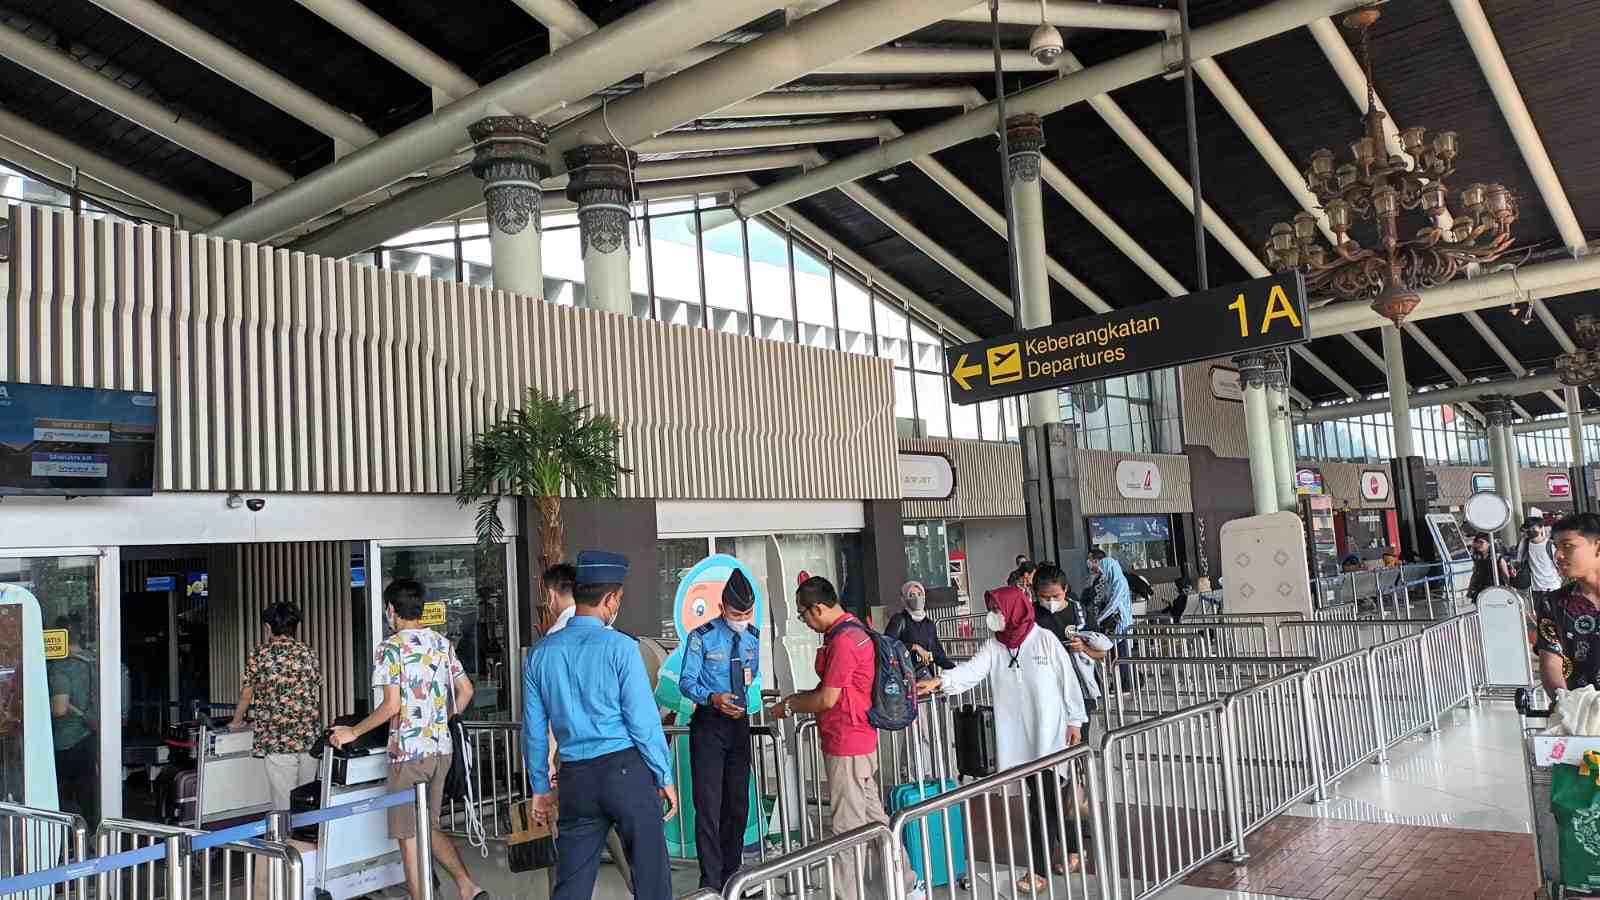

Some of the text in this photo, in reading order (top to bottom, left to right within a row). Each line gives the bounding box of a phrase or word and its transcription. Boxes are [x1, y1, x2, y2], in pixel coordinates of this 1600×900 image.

[1228, 285, 1302, 337] 1A
[1024, 314, 1161, 356] Keberangkatan
[1027, 346, 1126, 380] Departures
